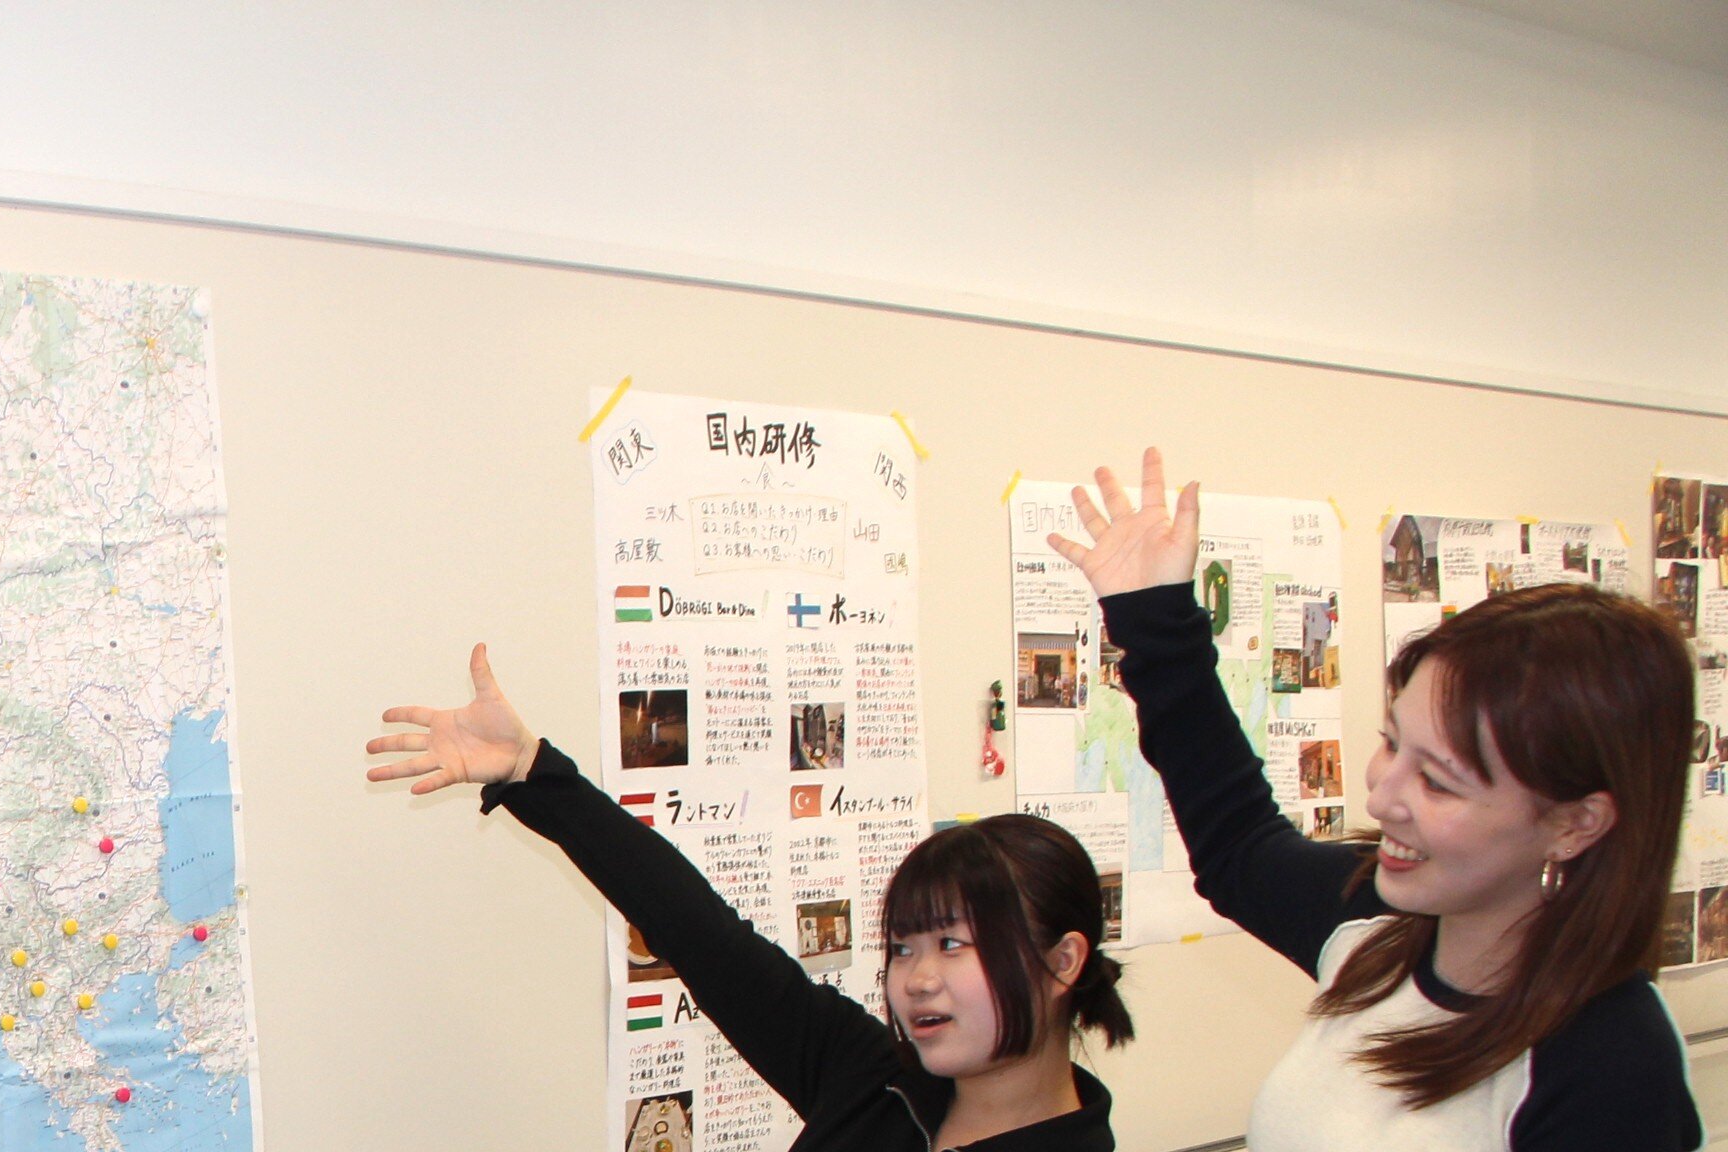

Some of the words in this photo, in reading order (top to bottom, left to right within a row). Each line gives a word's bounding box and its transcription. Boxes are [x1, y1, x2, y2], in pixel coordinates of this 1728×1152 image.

[607, 427, 655, 477] 関東
[705, 411, 823, 470] 国内研修
[872, 450, 909, 501] 関西
[853, 517, 881, 543] 山田
[1021, 501, 1081, 533] 国内研
